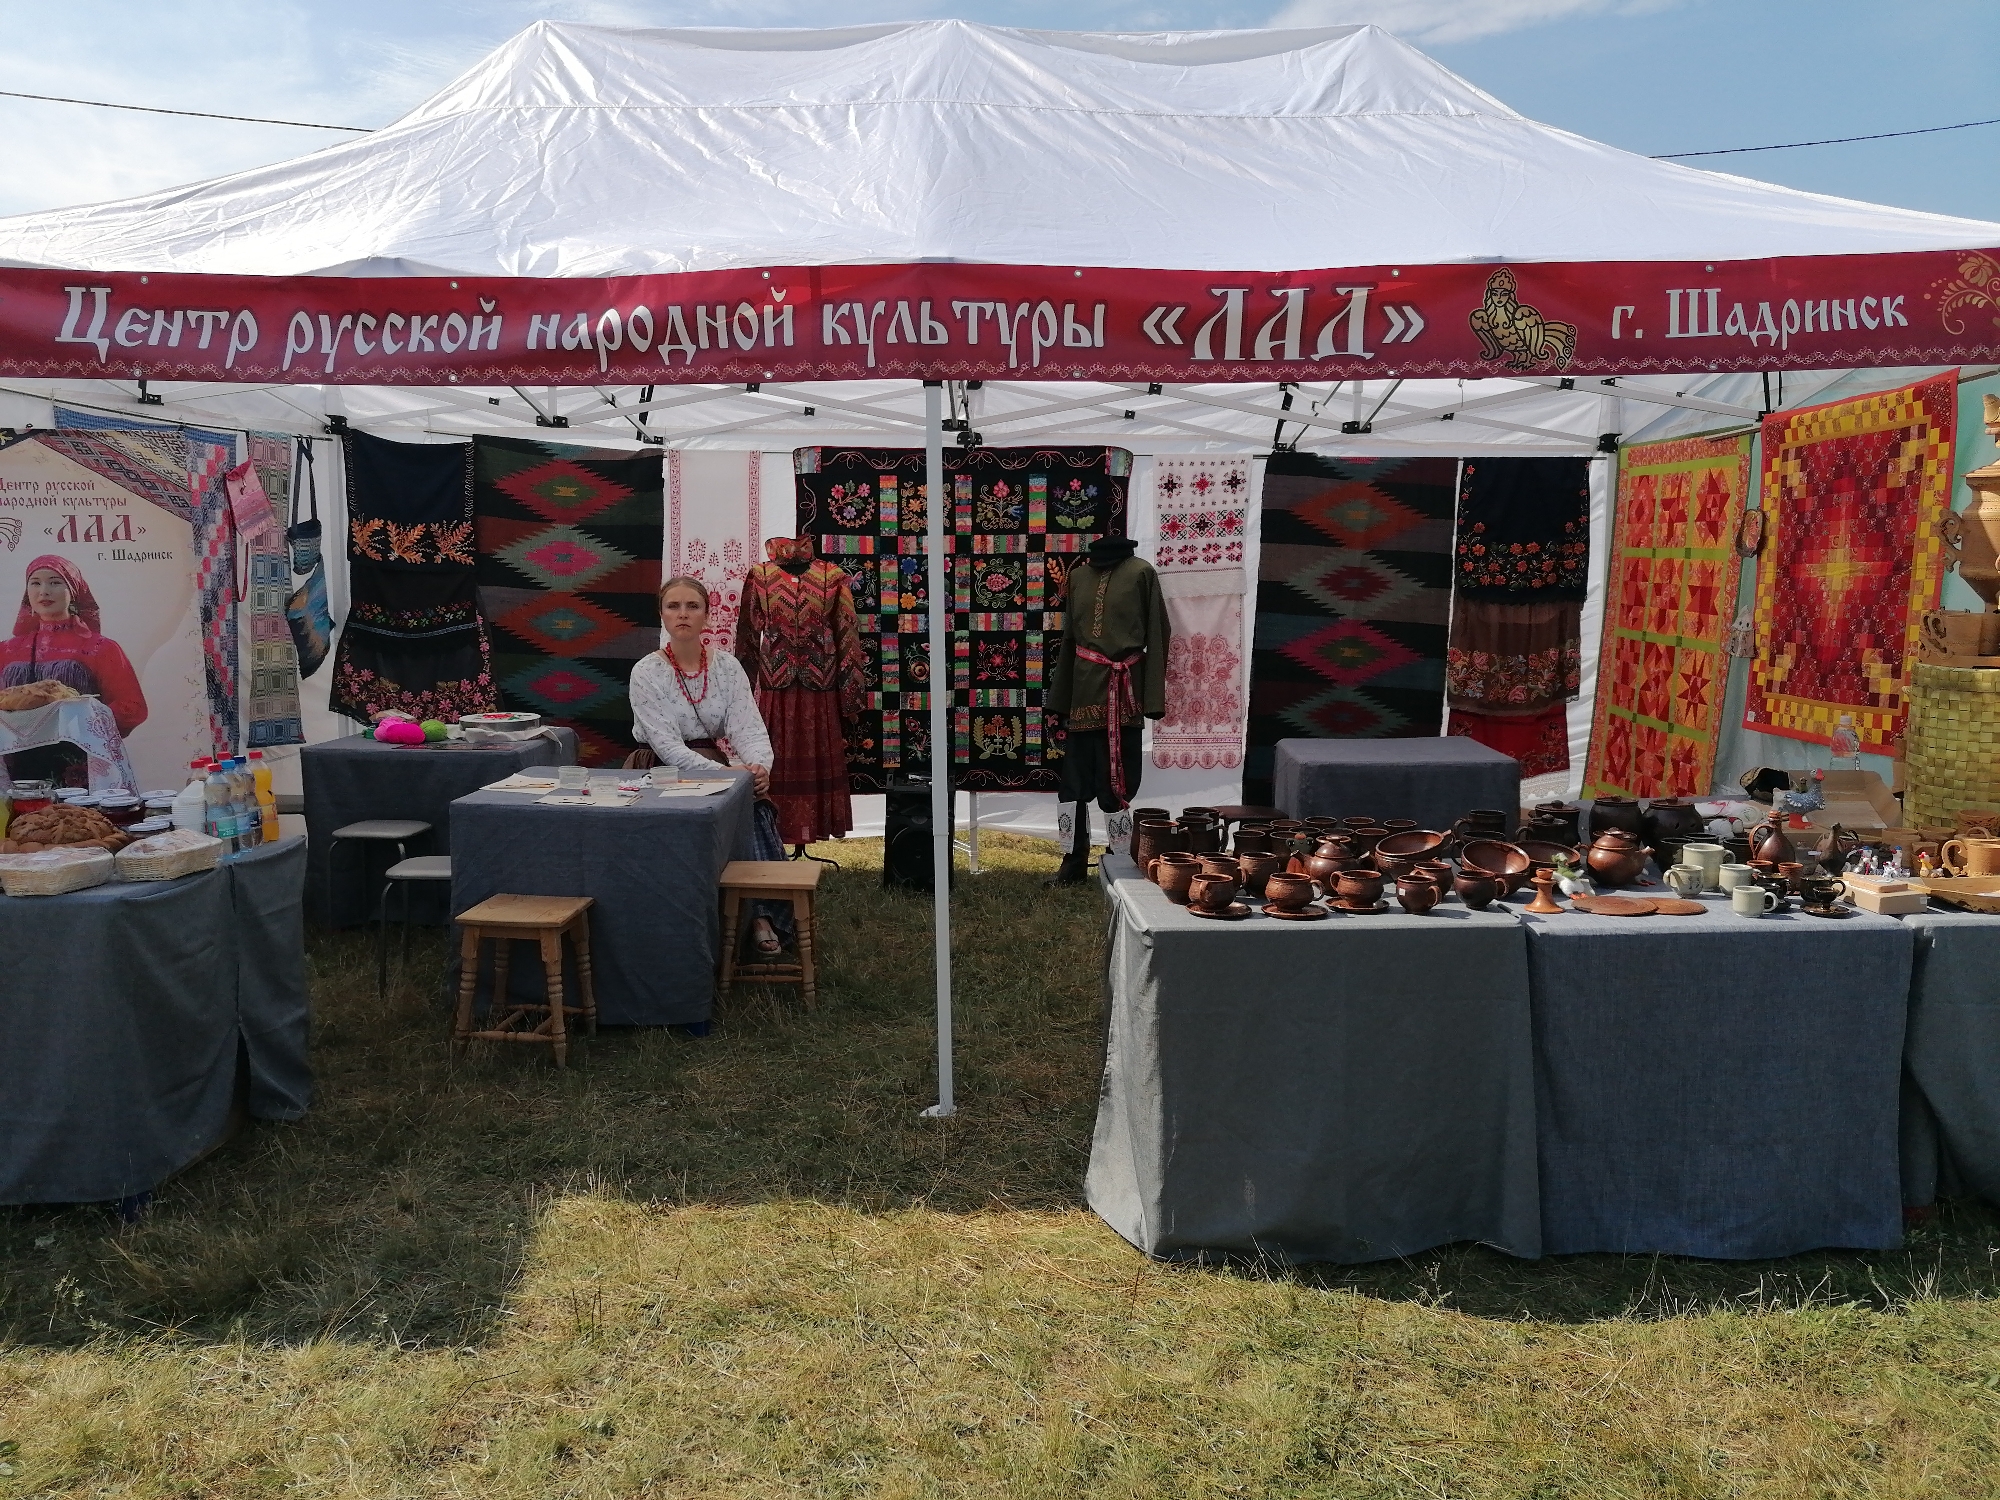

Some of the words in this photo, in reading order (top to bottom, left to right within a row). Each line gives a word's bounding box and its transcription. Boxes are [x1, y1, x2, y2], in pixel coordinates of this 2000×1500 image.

[55, 286, 259, 370] Центр
[282, 297, 503, 373] русской
[526, 286, 794, 373] народной
[822, 300, 1105, 369] культуры
[1142, 286, 1425, 362] «ЛАД»
[1611, 305, 1644, 339] г.
[1665, 287, 1909, 351] Шадринск
[45, 480, 95, 495] русской
[62, 497, 127, 510] культуры
[43, 514, 147, 543] «ЛАД»
[97, 552, 107, 561] г.
[111, 548, 173, 563] Шадринск
